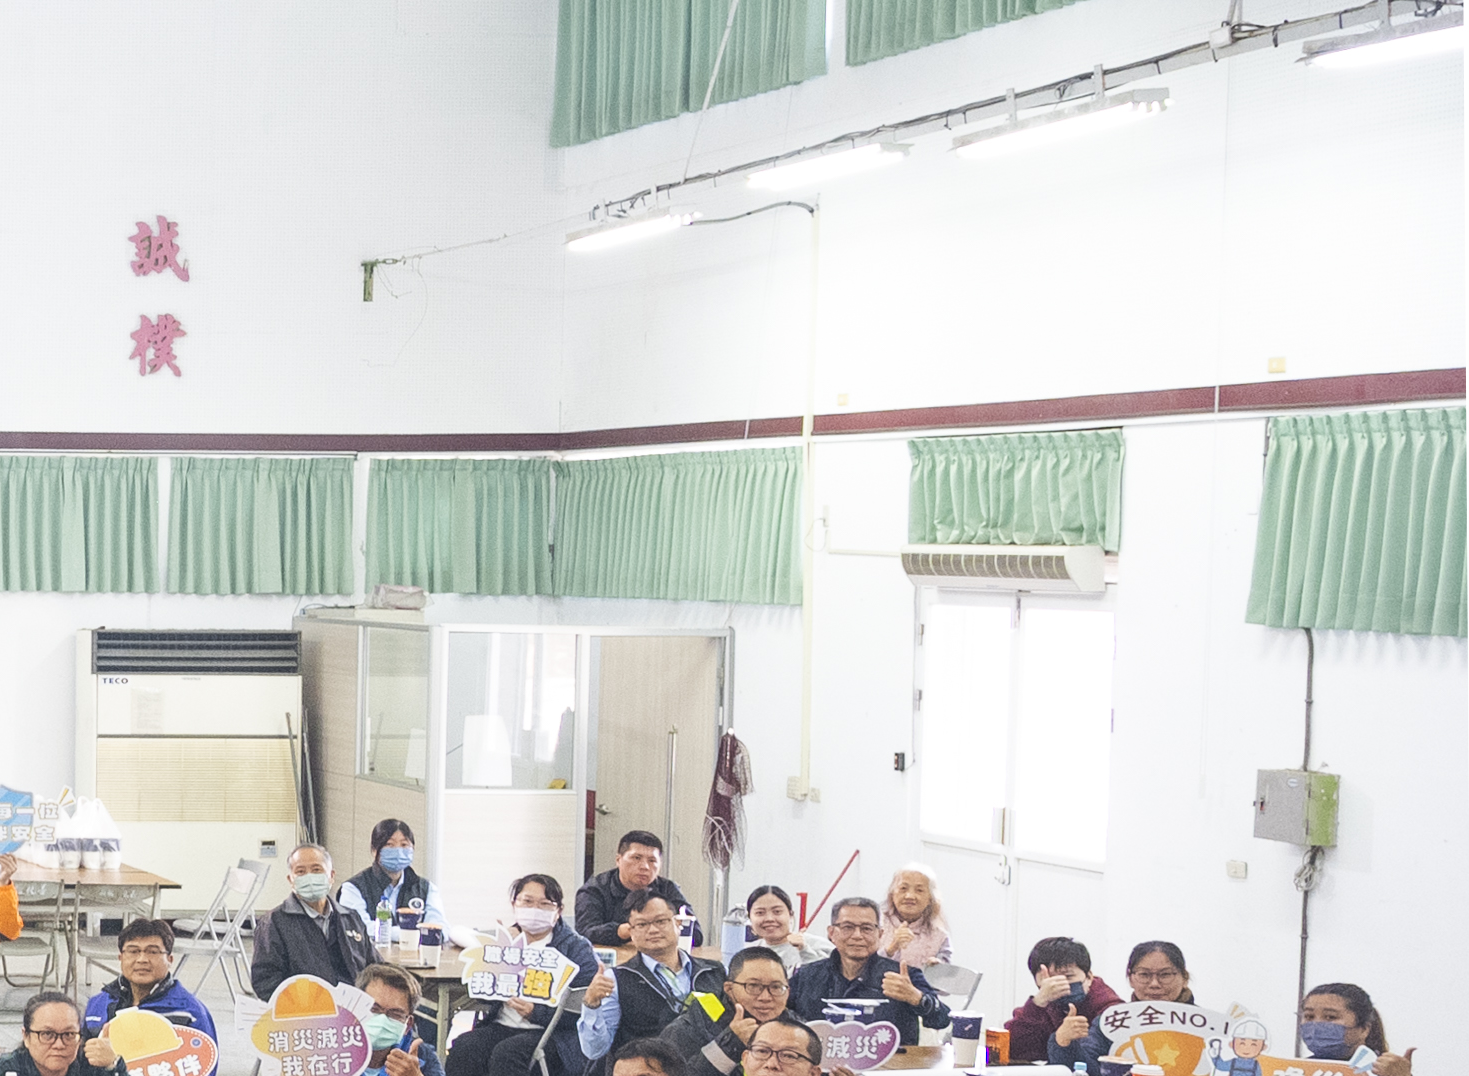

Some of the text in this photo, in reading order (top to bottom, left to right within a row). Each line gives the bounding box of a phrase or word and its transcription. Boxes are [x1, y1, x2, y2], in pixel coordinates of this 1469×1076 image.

[126, 214, 191, 378] 誠樸
[483, 945, 559, 968] 職場安全
[1104, 1005, 1229, 1035] 安全NO.1
[268, 1025, 364, 1053] 消災減災
[820, 1035, 878, 1060] 減災
